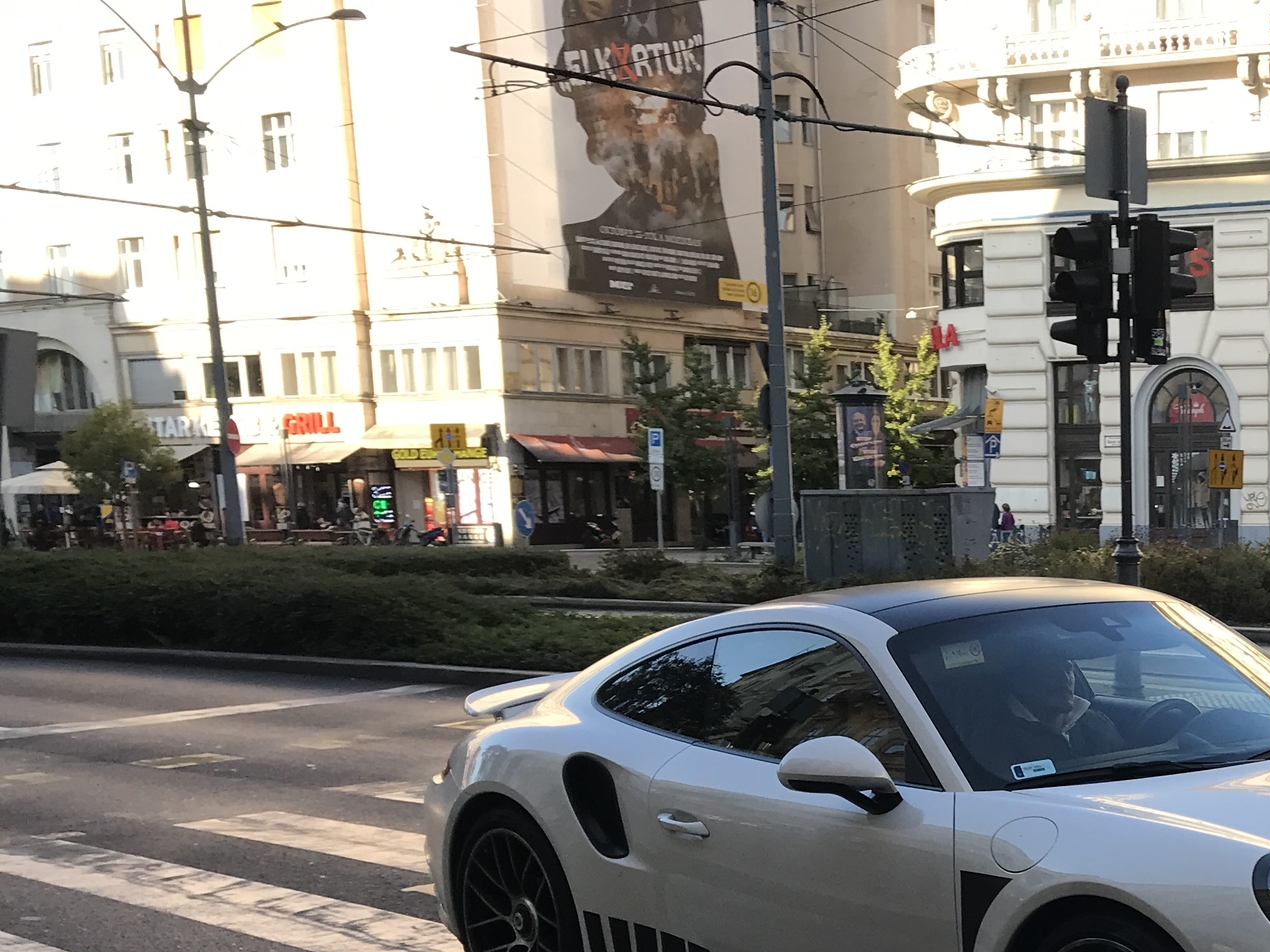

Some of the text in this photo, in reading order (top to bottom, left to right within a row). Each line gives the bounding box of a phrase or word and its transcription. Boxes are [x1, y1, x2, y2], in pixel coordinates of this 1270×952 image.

[282, 411, 341, 435] GRILL
[989, 439, 998, 453] P
[392, 449, 418, 460] GOLD
